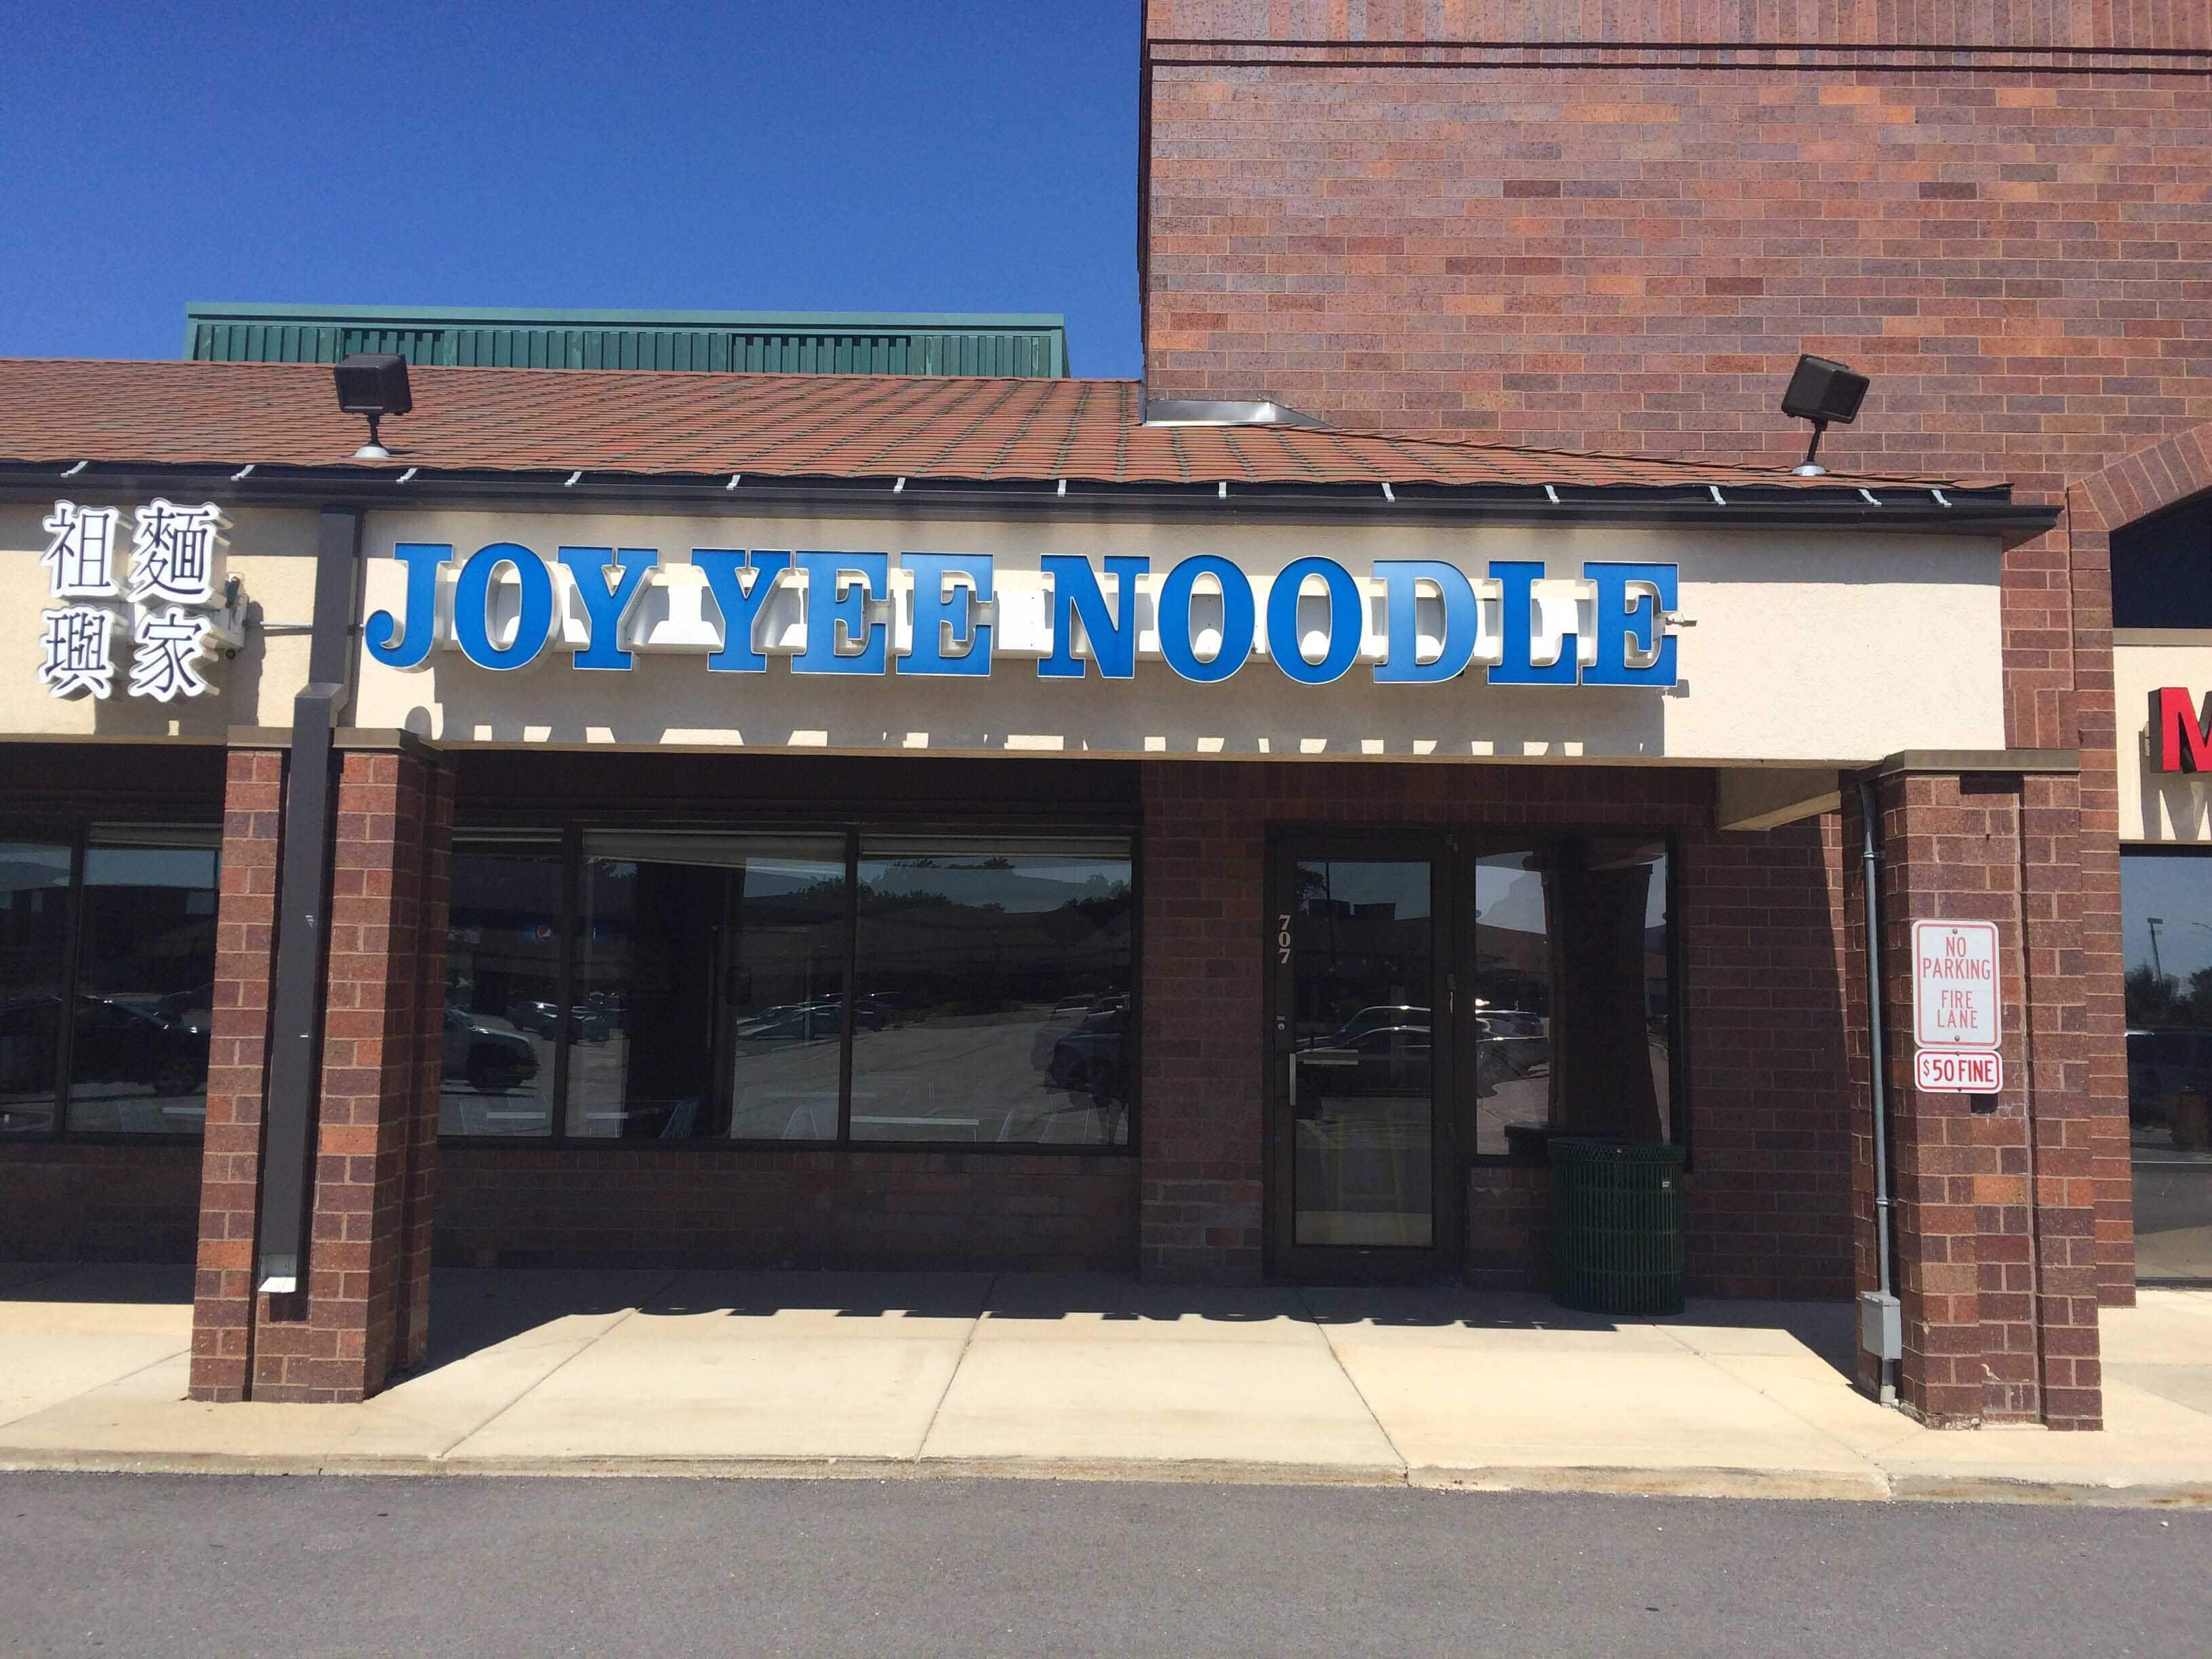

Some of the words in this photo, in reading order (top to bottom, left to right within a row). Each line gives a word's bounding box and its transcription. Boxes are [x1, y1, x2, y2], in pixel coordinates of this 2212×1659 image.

[364, 541, 659, 672] JOY
[691, 548, 995, 676] YEE
[1037, 553, 1679, 686] NOODLE
[1278, 914, 1291, 964] 707
[1946, 937, 1966, 958] NO
[1923, 958, 1990, 980] PARKING
[1942, 990, 1973, 1010] FIRE
[1937, 1010, 1978, 1029] LANE
[1923, 1059, 1954, 1082] $50
[1958, 1059, 1994, 1082] FINE
